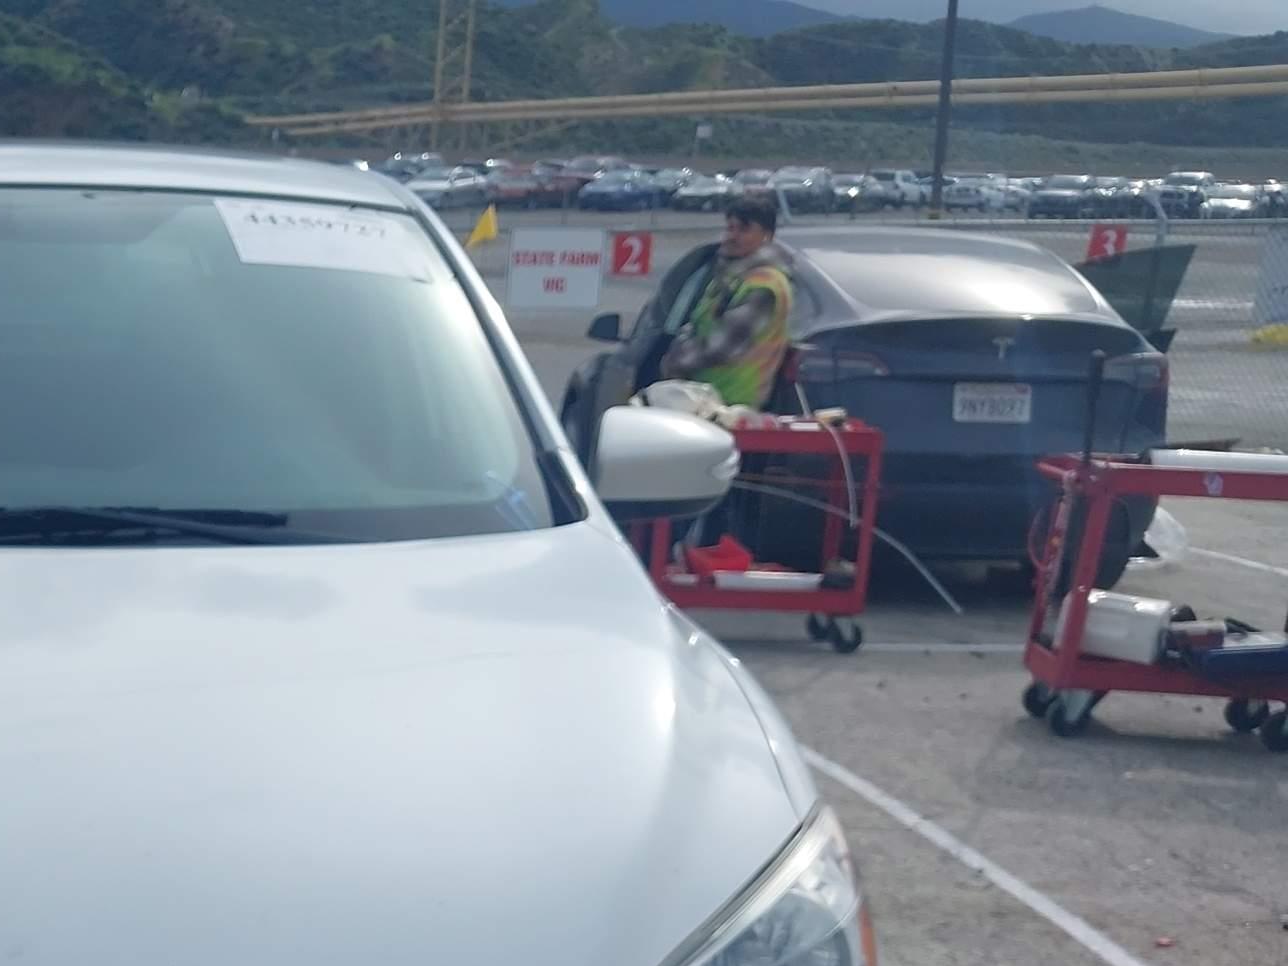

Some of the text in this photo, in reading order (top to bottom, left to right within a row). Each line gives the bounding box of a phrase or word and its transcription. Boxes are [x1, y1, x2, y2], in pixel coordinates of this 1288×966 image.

[619, 236, 643, 273] 2
[1101, 229, 1117, 255] 3
[512, 251, 601, 266] STATE FARM
